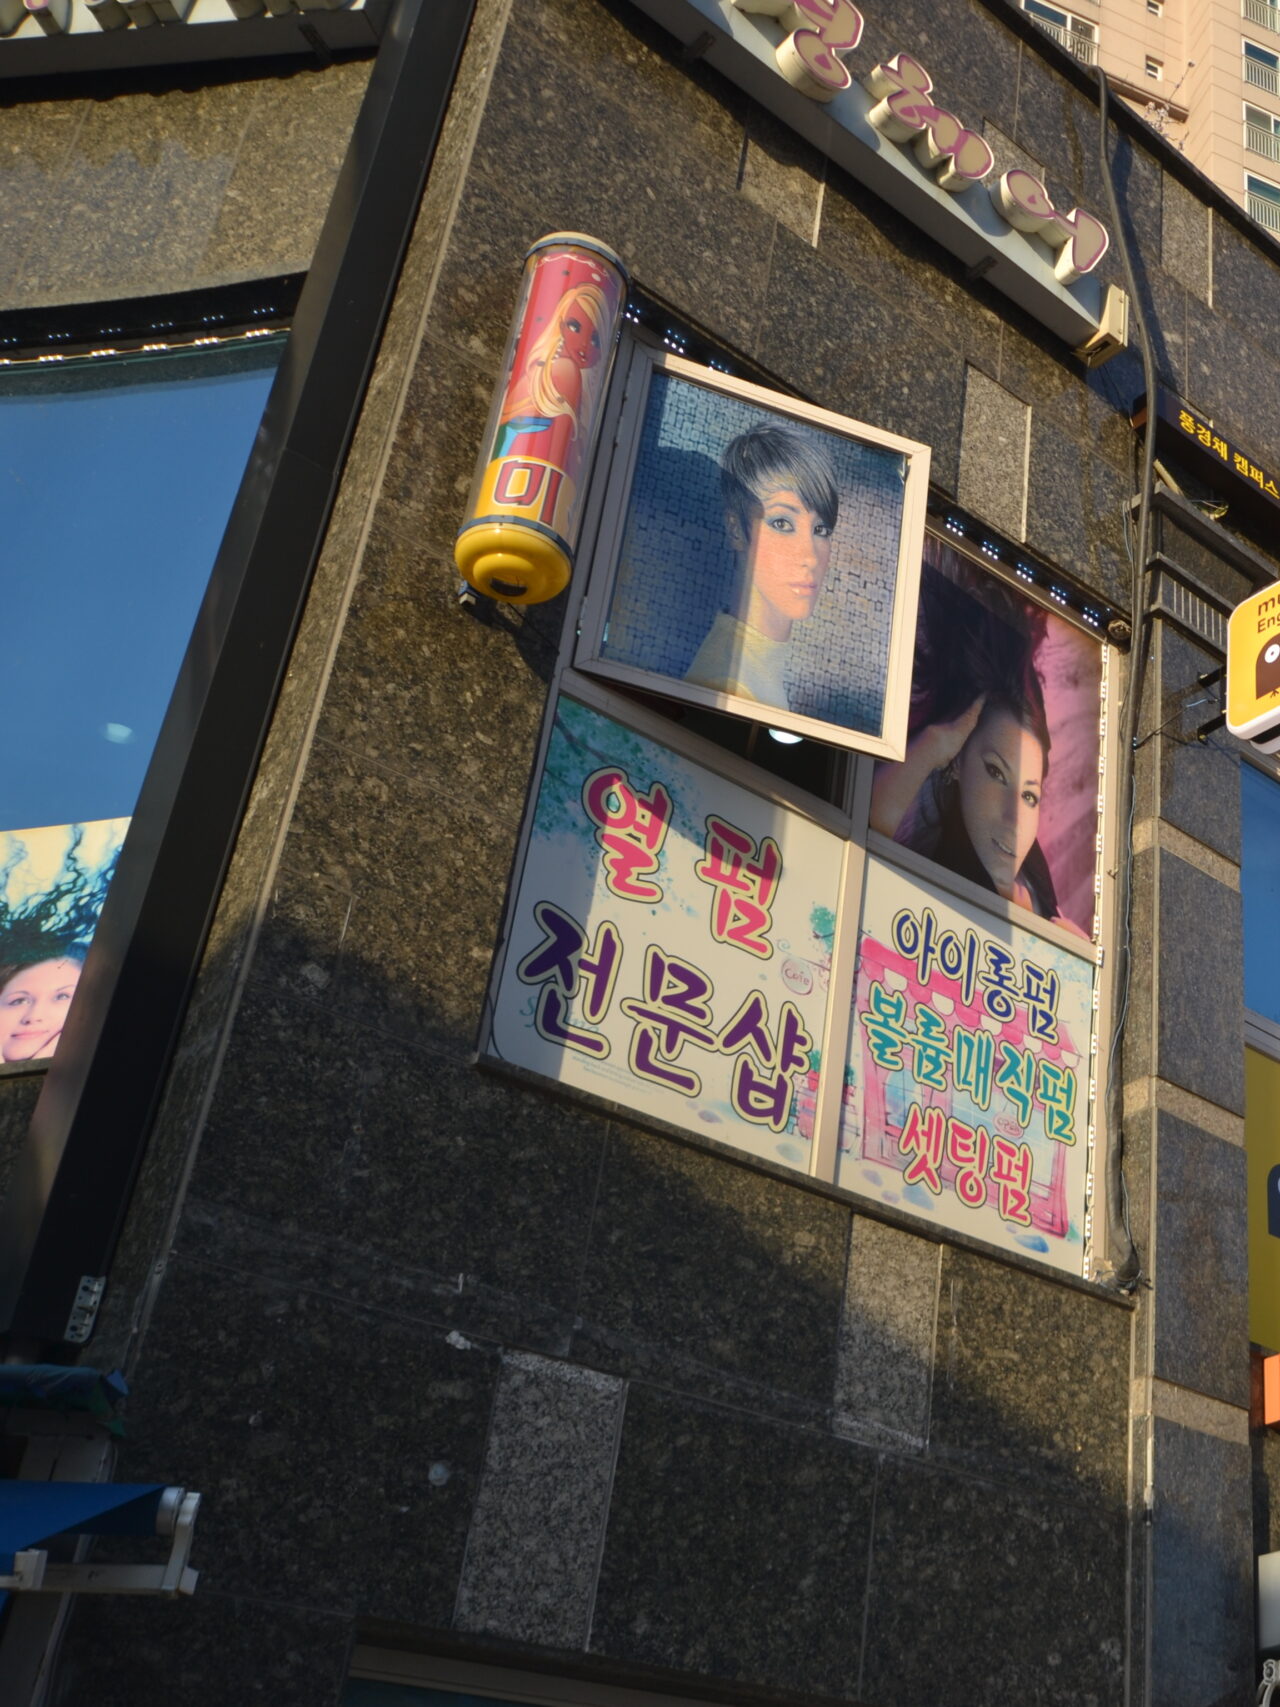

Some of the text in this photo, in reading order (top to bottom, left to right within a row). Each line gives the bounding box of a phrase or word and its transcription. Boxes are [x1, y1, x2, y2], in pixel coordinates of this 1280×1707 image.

[1178, 409, 1228, 461] 풍경채
[1233, 452, 1280, 499] 캠퍼스
[584, 767, 782, 959] 열 펌
[518, 902, 812, 1132] 전문샵
[893, 908, 1060, 1044] 아이롱펌
[861, 981, 1077, 1146] 볼륨매직펌
[900, 1103, 1032, 1226] 셋팅펌
